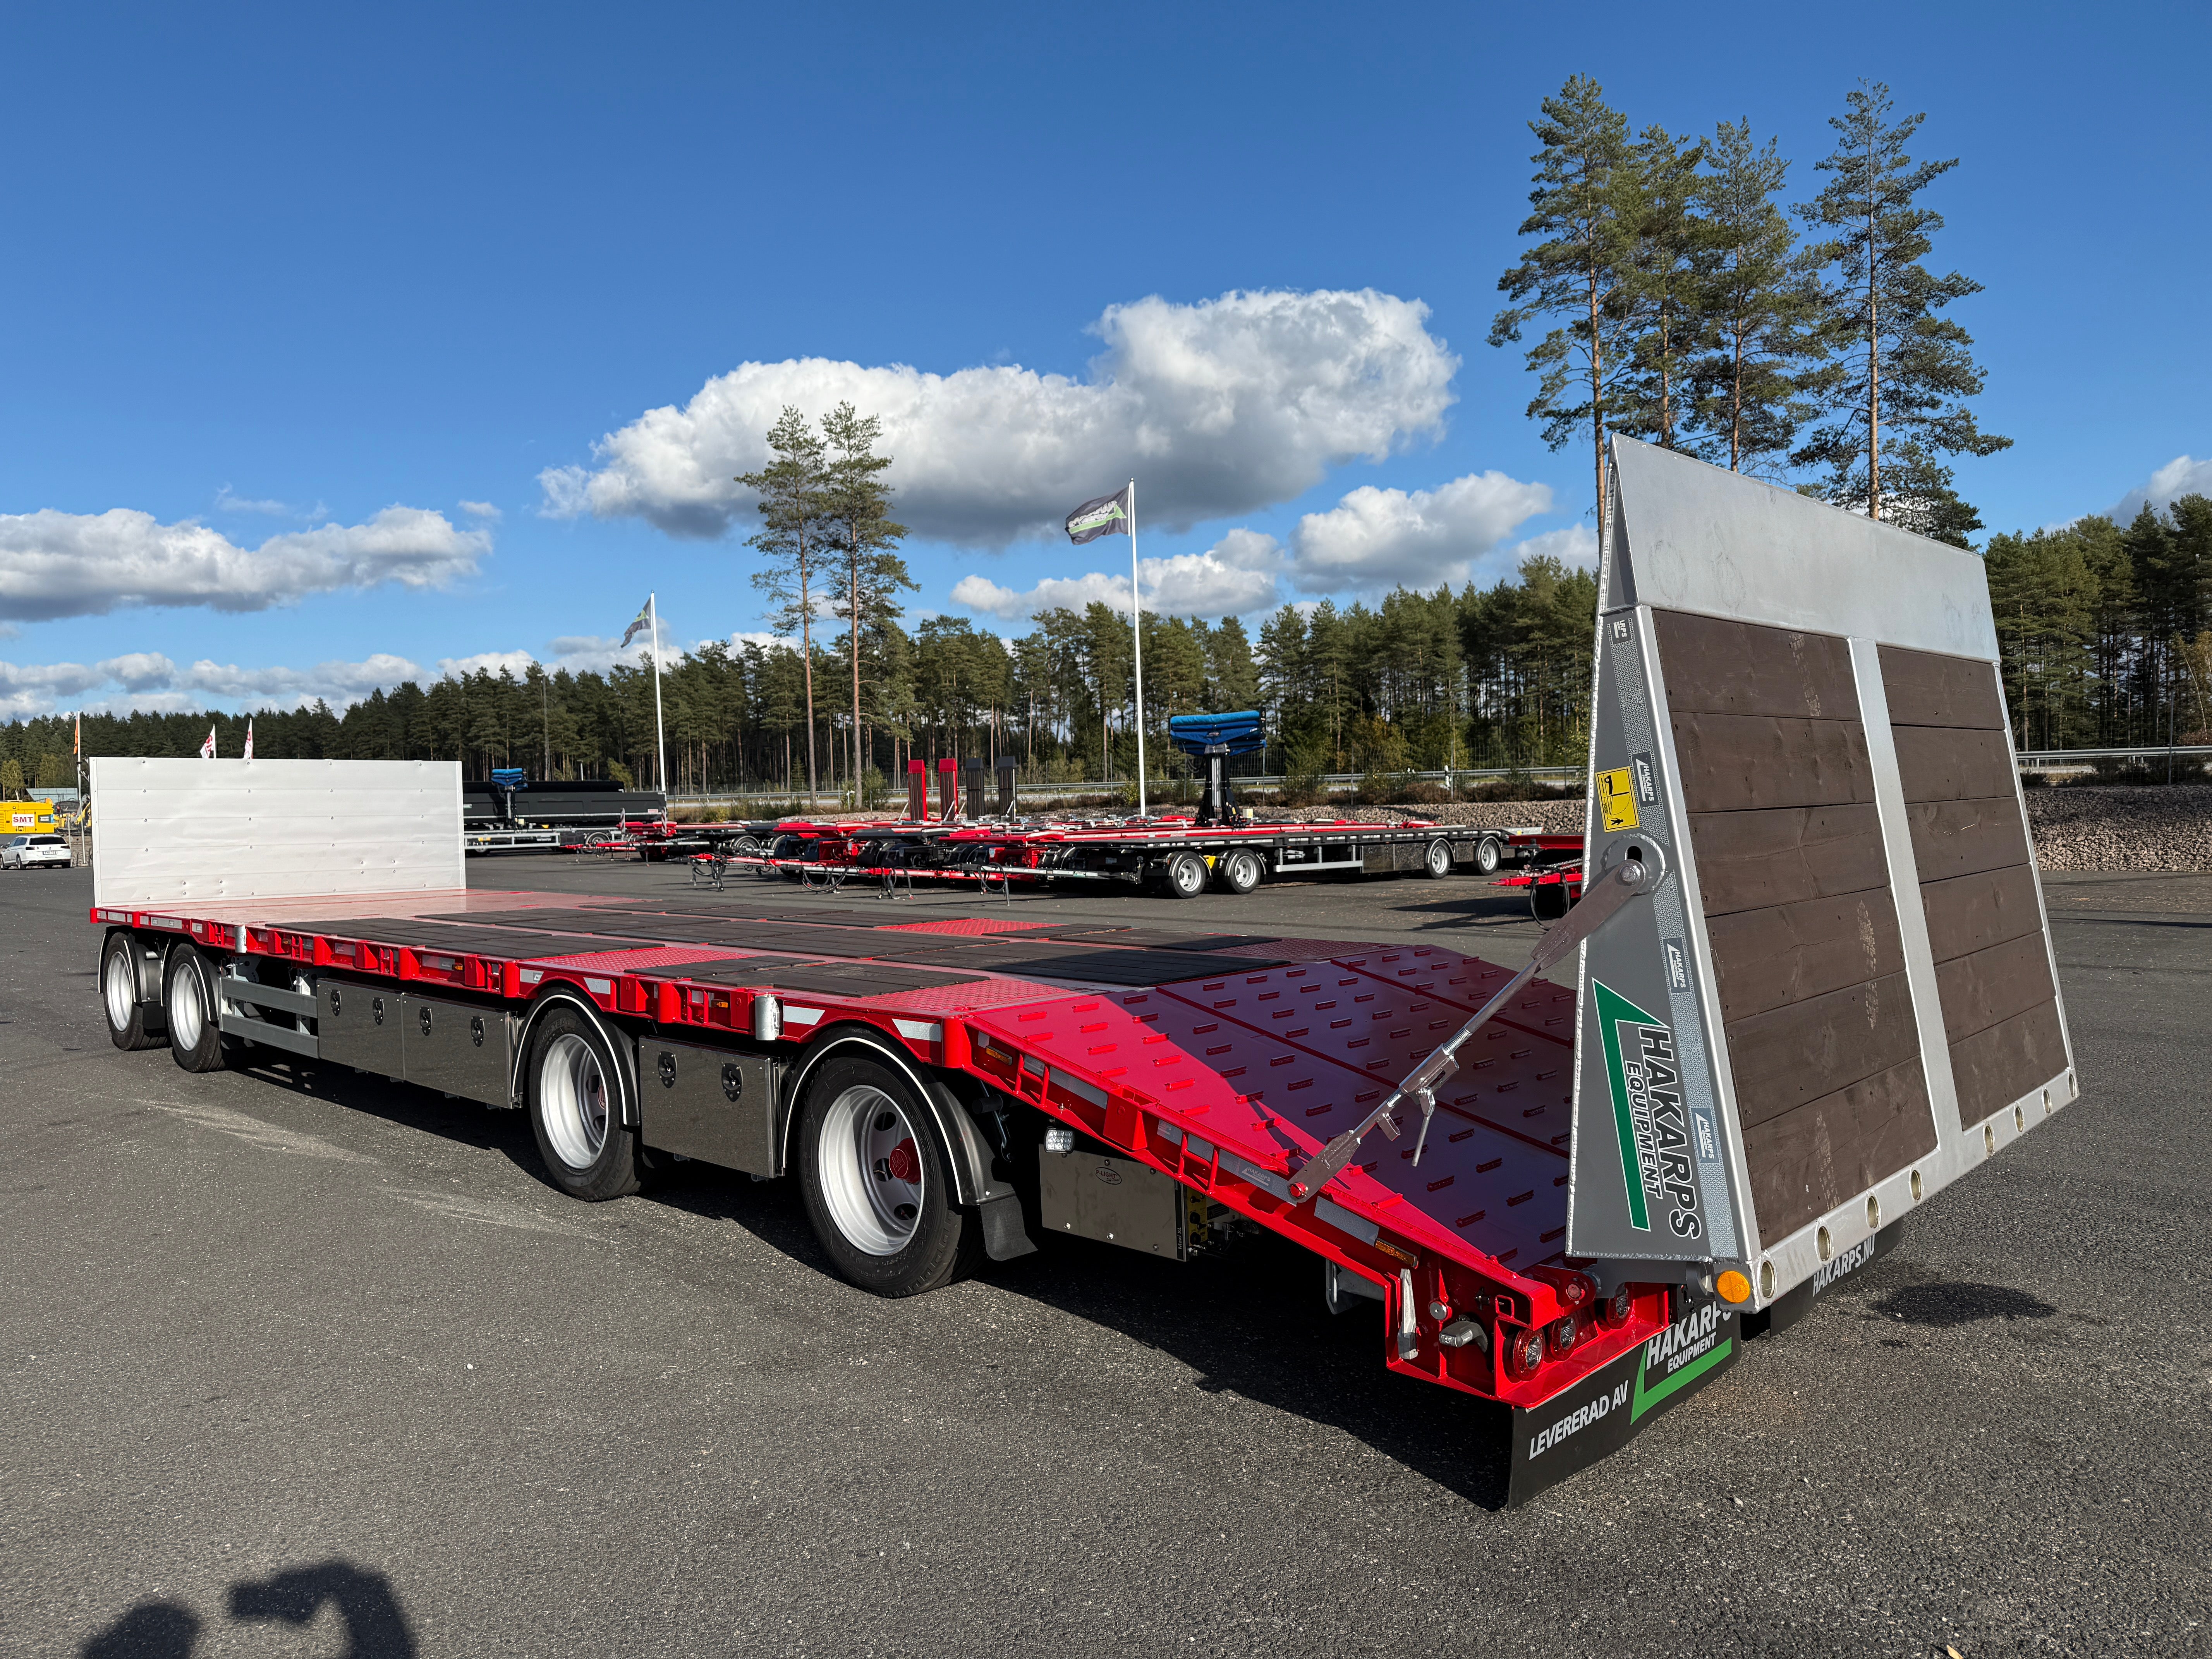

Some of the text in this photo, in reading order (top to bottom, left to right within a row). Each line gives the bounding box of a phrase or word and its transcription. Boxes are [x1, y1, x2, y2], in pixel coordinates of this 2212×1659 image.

[1644, 766, 1654, 801] HAKARPS
[1674, 951, 1686, 988] HAKARPS
[1625, 1060, 1663, 1200] EQUIPMENT
[1638, 1026, 1702, 1240] HAKARPS
[1703, 1121, 1715, 1159] HAKARPS
[1247, 1167, 1271, 1182] HAKARPS
[1813, 1234, 1875, 1297] HAKARPS.NU
[1667, 1331, 1717, 1374] EQUIPMENT
[1529, 1379, 1628, 1461] LEVERERAD AV
